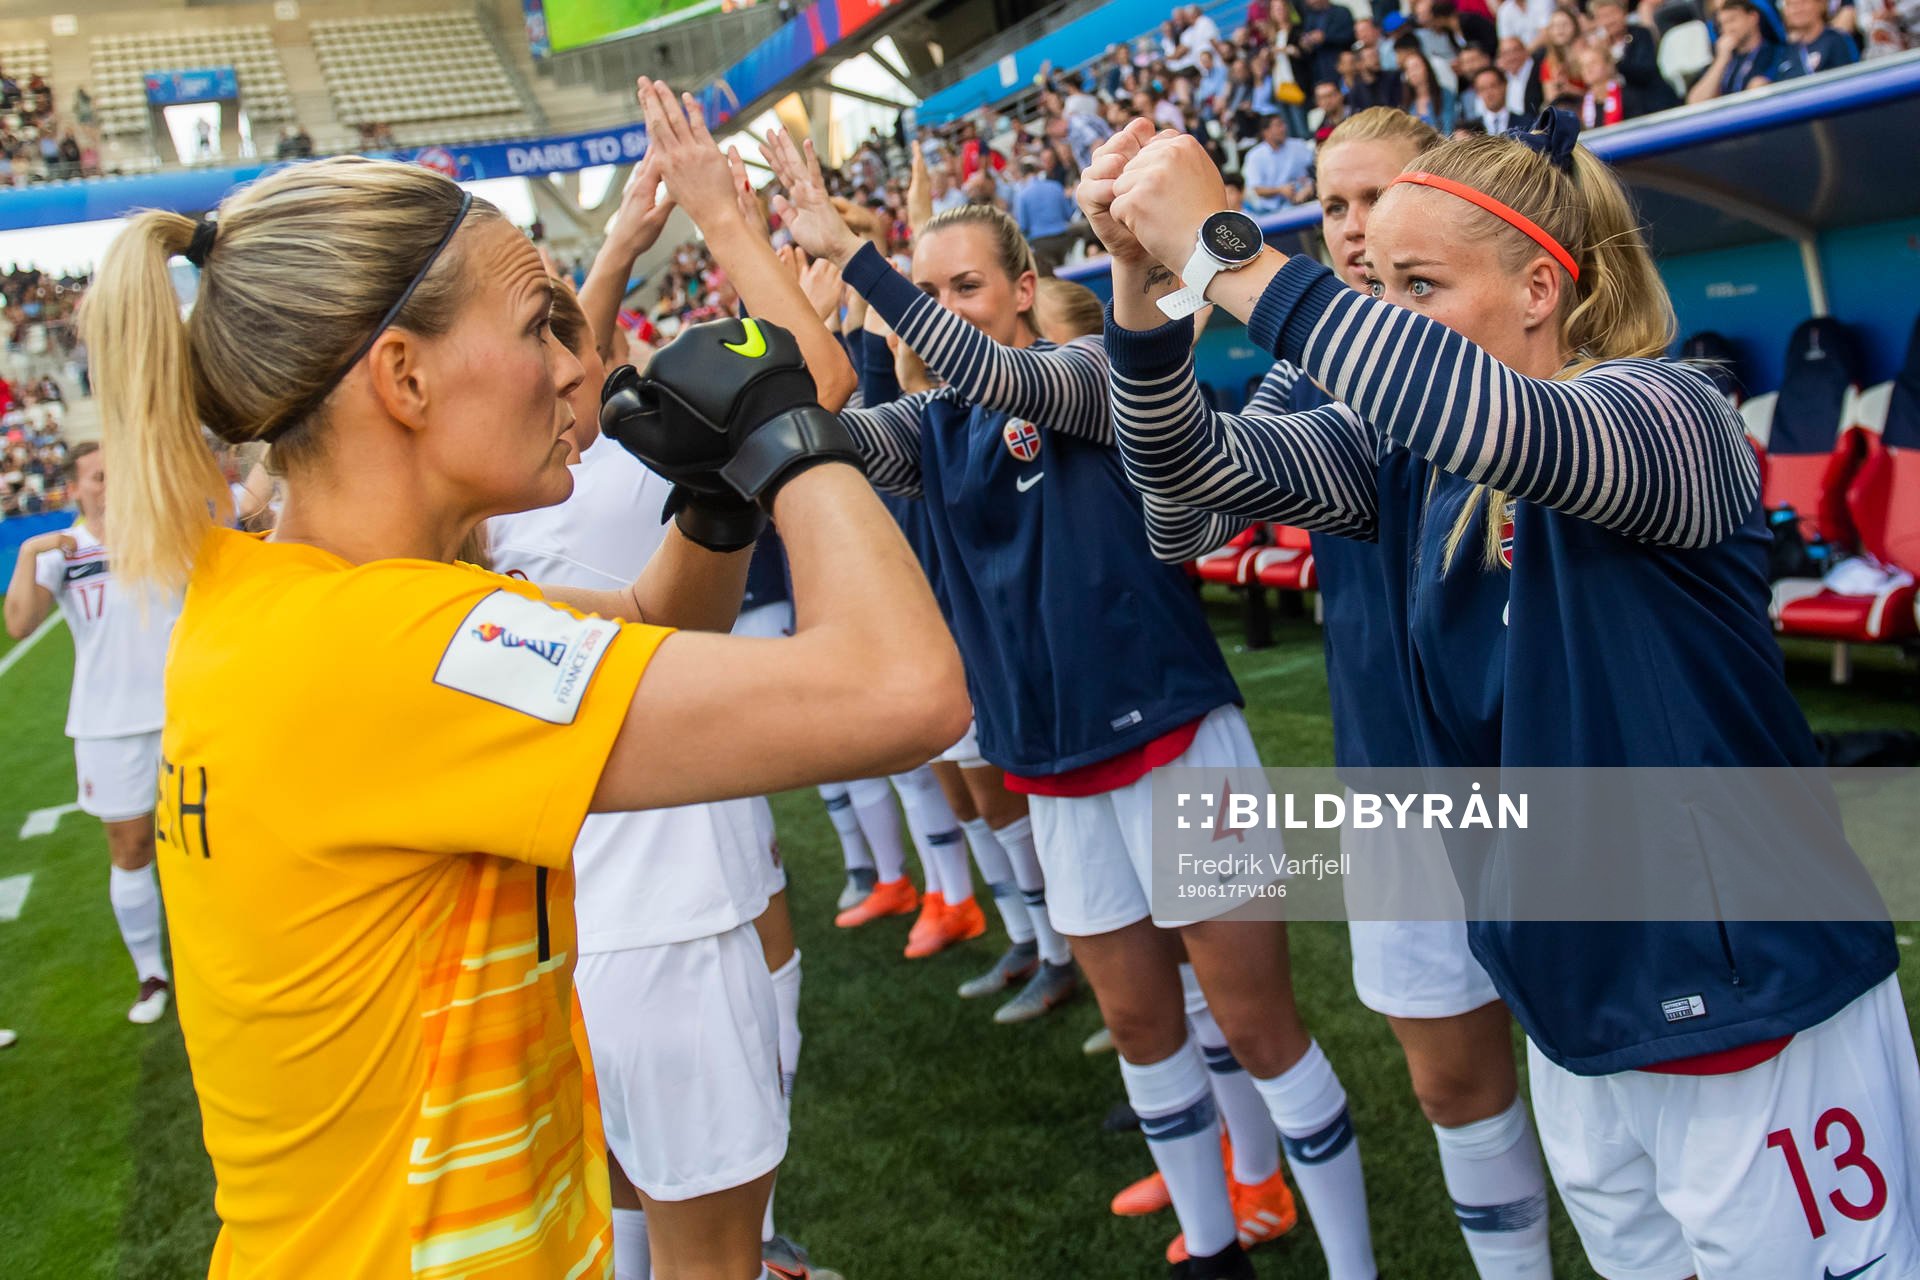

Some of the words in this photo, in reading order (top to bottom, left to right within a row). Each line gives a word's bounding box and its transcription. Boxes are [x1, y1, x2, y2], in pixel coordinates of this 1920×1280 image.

[507, 142, 581, 174] DARE
[582, 136, 620, 163] TO
[1215, 224, 1247, 253] 20:58
[78, 583, 105, 621] 17
[556, 653, 589, 704] FRANCE
[1211, 776, 1245, 845] 4
[1766, 1107, 1888, 1241] 13
